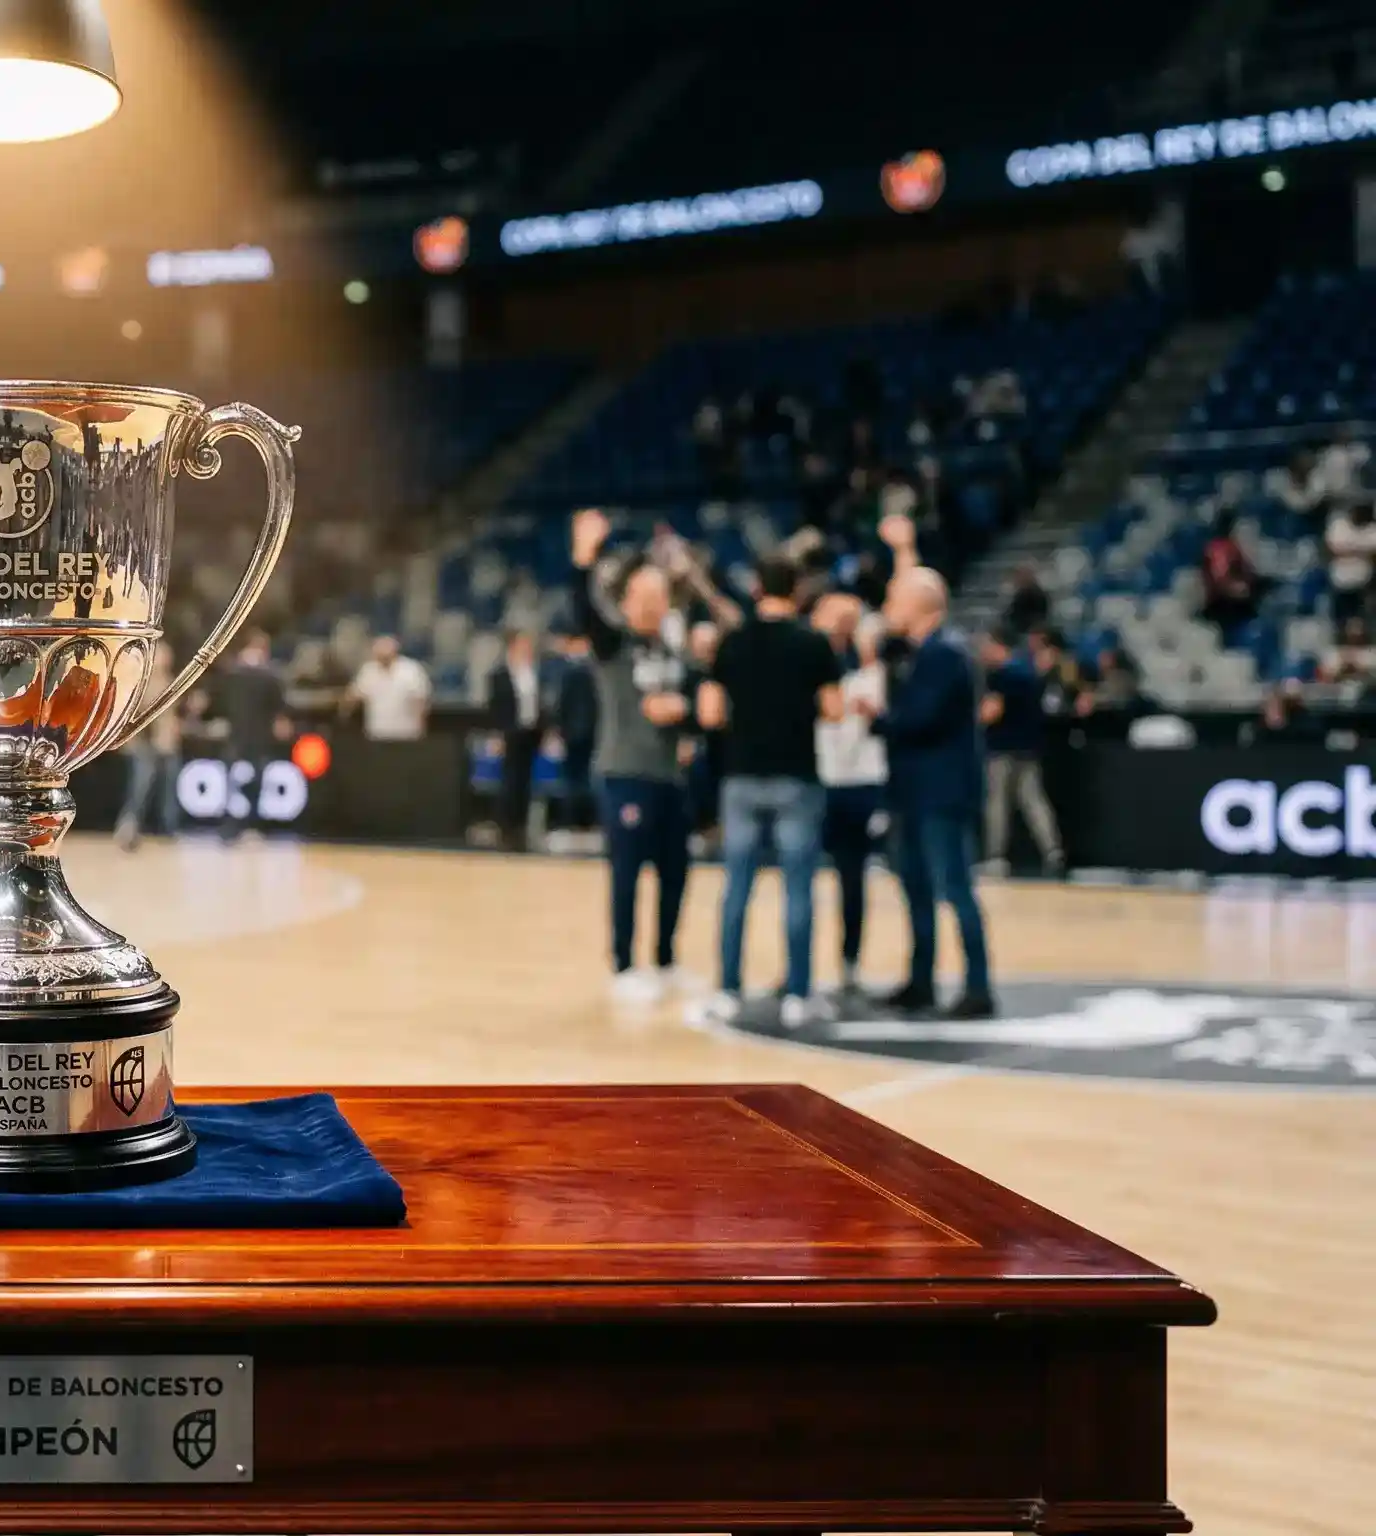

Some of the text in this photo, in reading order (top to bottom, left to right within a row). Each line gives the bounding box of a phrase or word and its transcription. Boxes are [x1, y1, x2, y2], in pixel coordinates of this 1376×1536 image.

[16, 472, 35, 518] acb
[58, 553, 111, 576] REY
[8, 1053, 50, 1071] DEL
[56, 1051, 95, 1070] REY
[8, 1377, 40, 1397] DE
[51, 1377, 224, 1397] BALONCESTO
